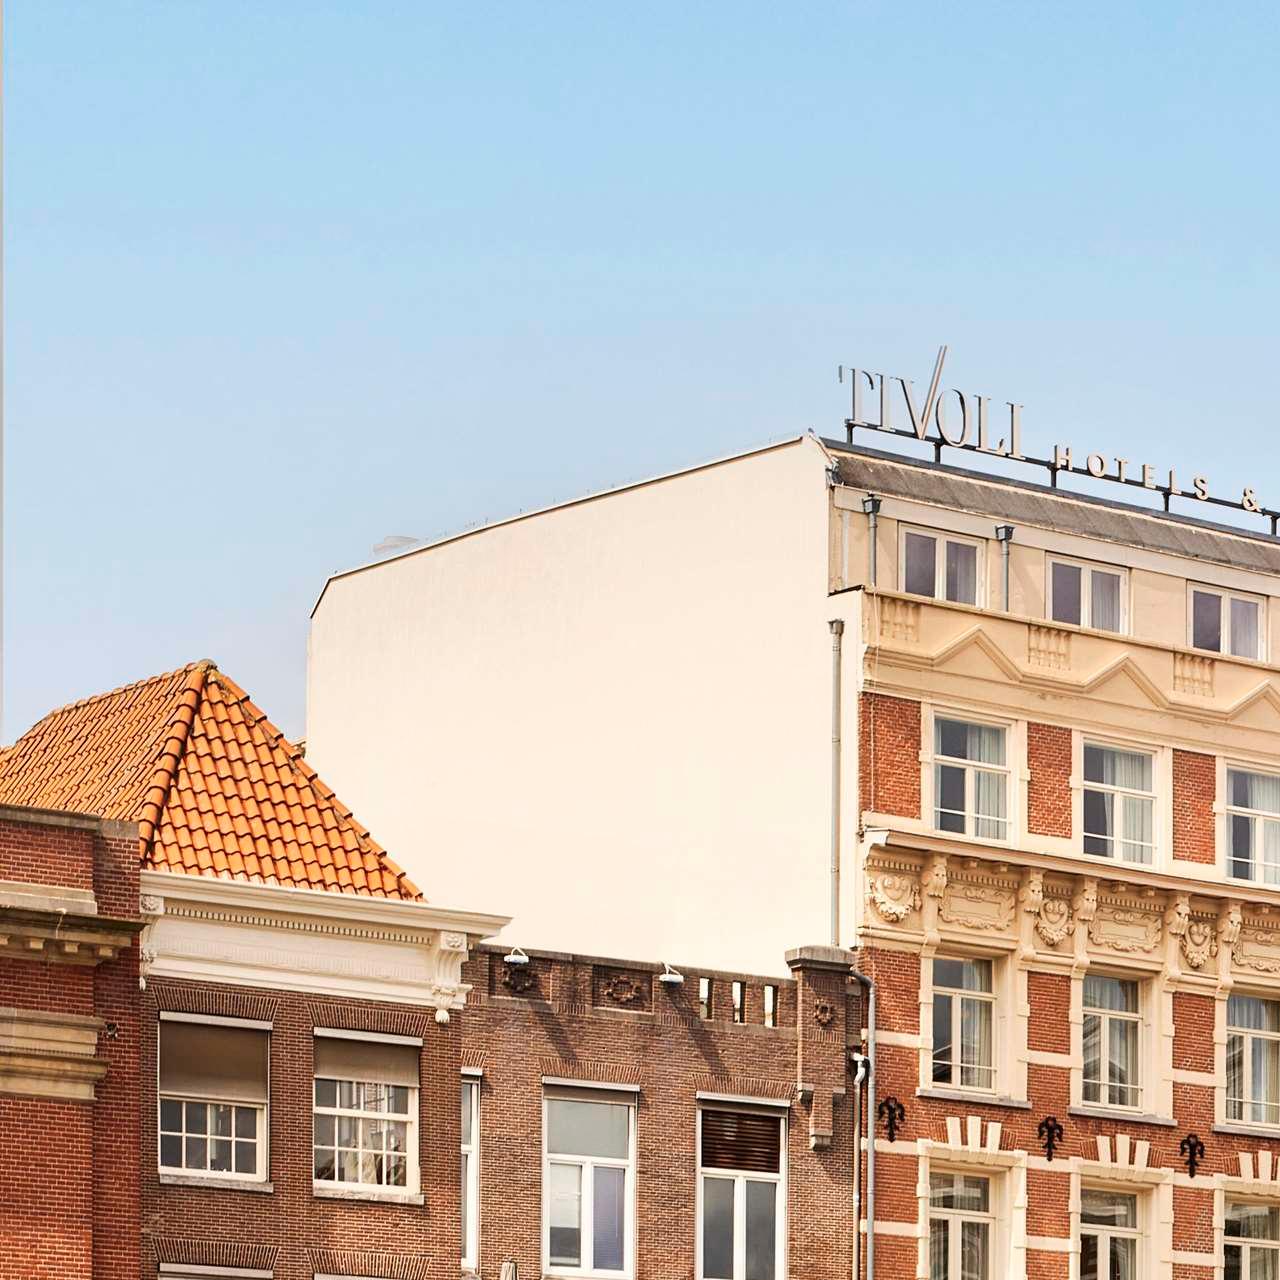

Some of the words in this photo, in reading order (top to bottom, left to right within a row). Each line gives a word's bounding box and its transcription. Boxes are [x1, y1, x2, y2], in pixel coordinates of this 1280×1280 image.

[838, 345, 1025, 460] TIVOLI
[1054, 445, 1209, 501] HOTELS
[1242, 487, 1261, 513] &
